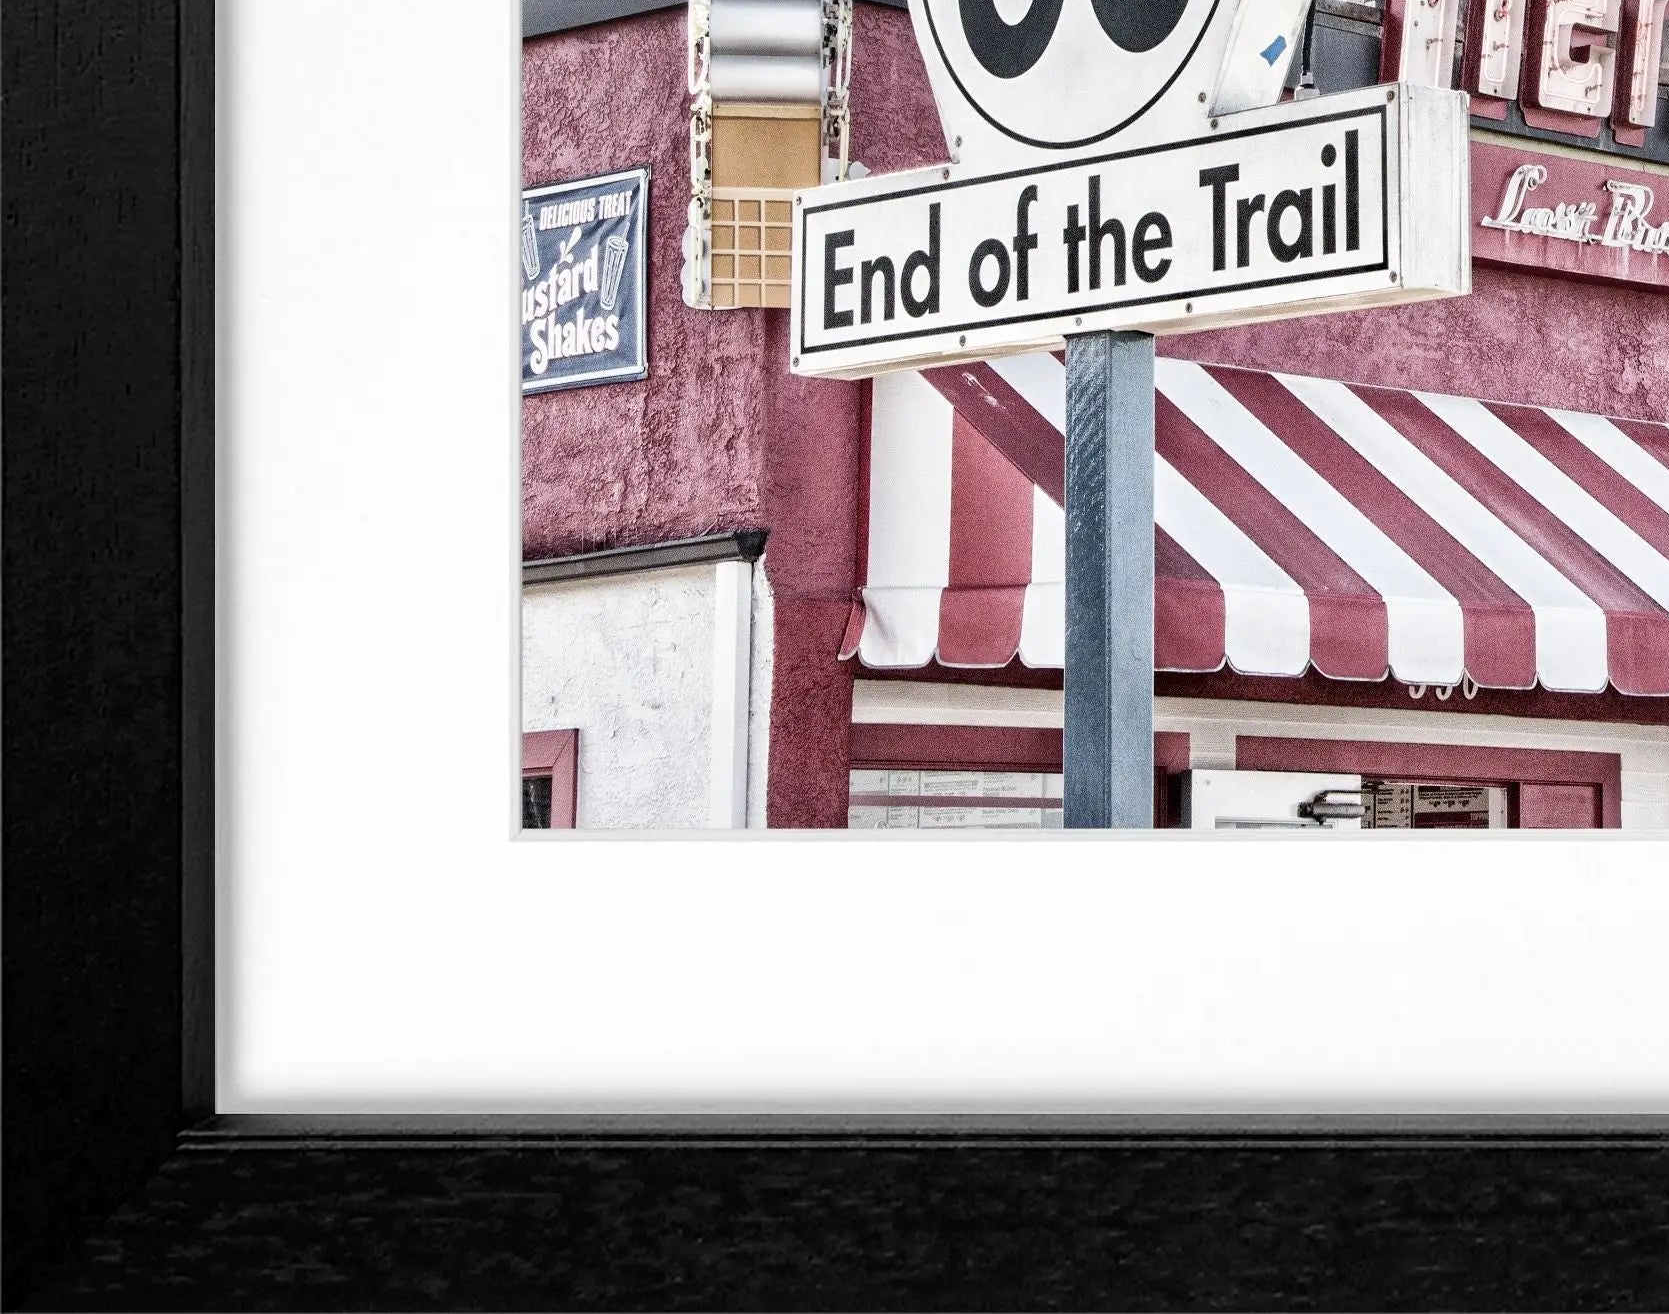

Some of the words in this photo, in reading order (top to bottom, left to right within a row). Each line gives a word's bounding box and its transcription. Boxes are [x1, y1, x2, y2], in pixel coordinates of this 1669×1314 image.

[538, 196, 596, 231] DELICIOUS
[598, 190, 633, 221] TREAT
[822, 203, 942, 330] End
[968, 184, 1039, 308] of
[1063, 174, 1174, 292] the
[1199, 129, 1360, 272] Trail
[1480, 164, 1600, 244] Last
[529, 305, 621, 375] Shakes
